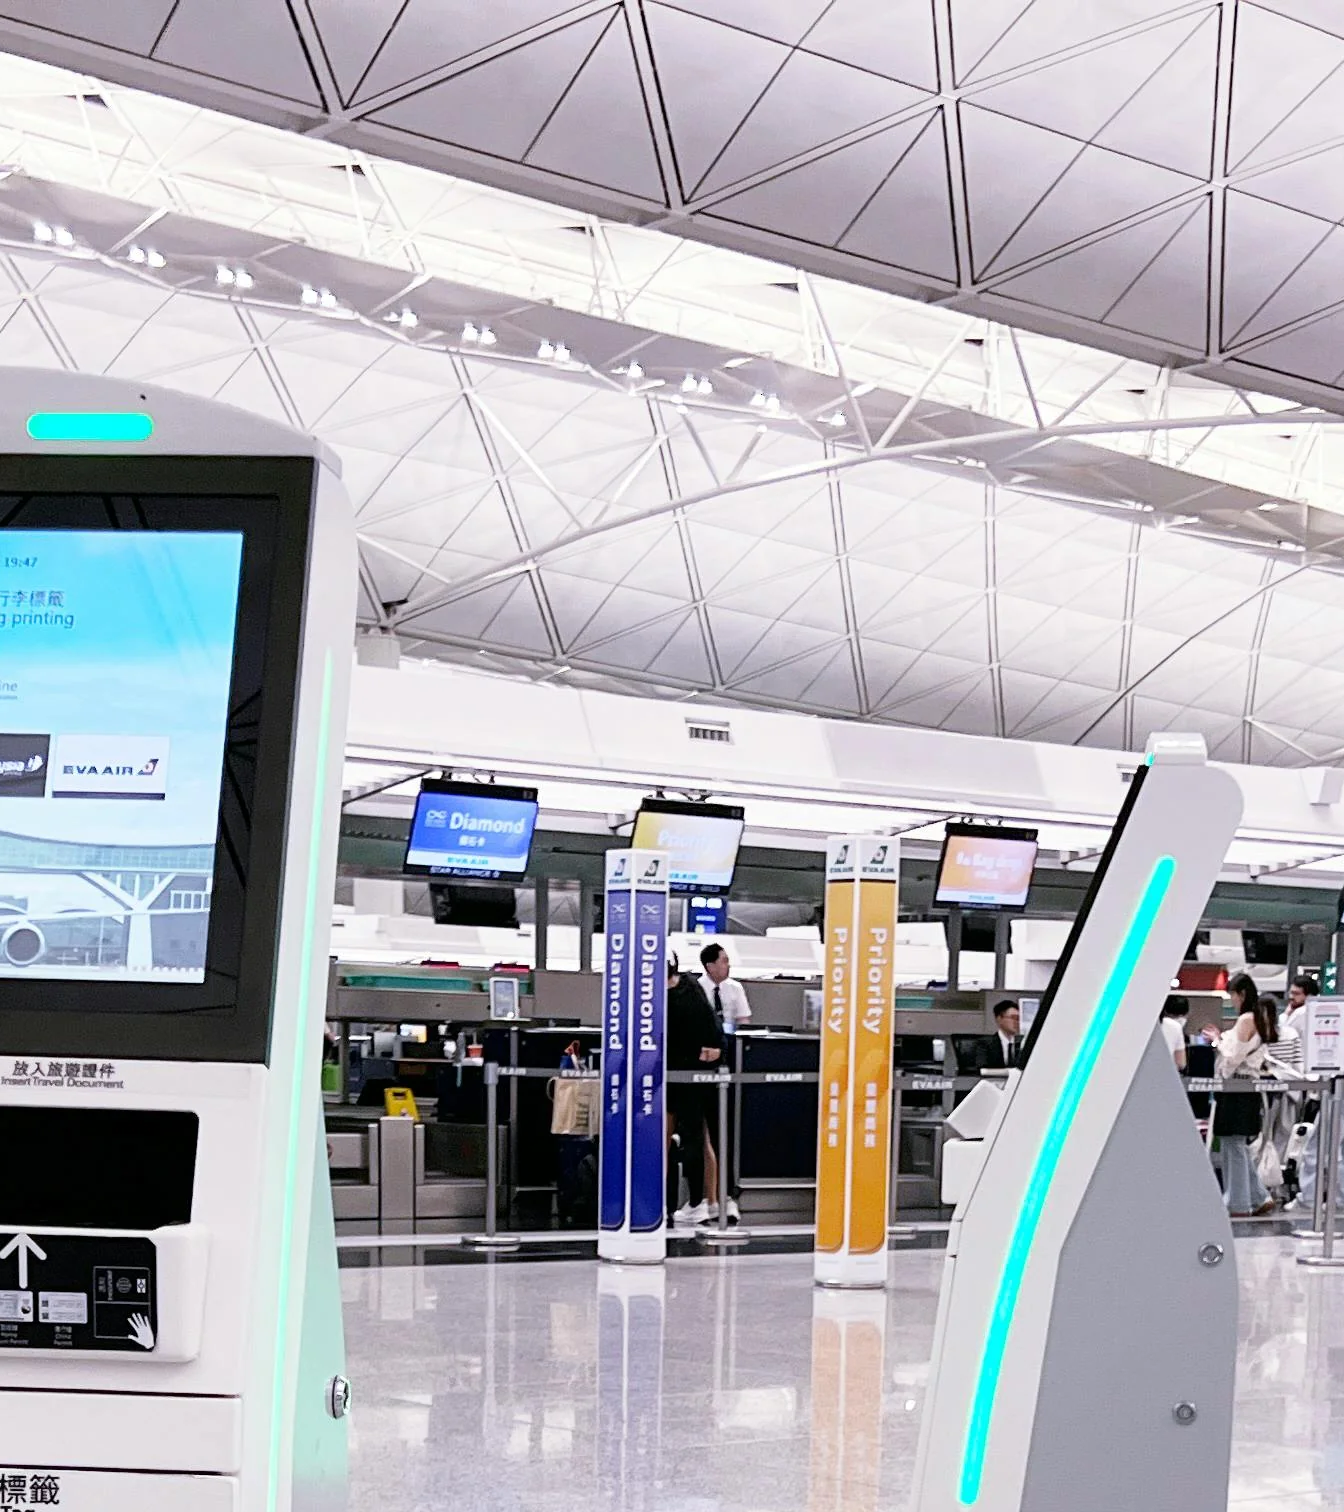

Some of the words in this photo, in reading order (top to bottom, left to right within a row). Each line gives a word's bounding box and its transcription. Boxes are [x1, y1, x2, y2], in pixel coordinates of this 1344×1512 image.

[4, 557, 38, 568] 19:47
[11, 611, 75, 629] printing
[449, 811, 526, 834] Diamond
[608, 933, 625, 1050] Diamond
[639, 934, 658, 1051] Diamond
[827, 927, 848, 1035] Priority
[862, 927, 888, 1036] Priority
[12, 1060, 116, 1080] 放入旅遊證件
[0, 1076, 32, 1087] Insert
[33, 1077, 65, 1088] Travel
[66, 1078, 125, 1090] Document
